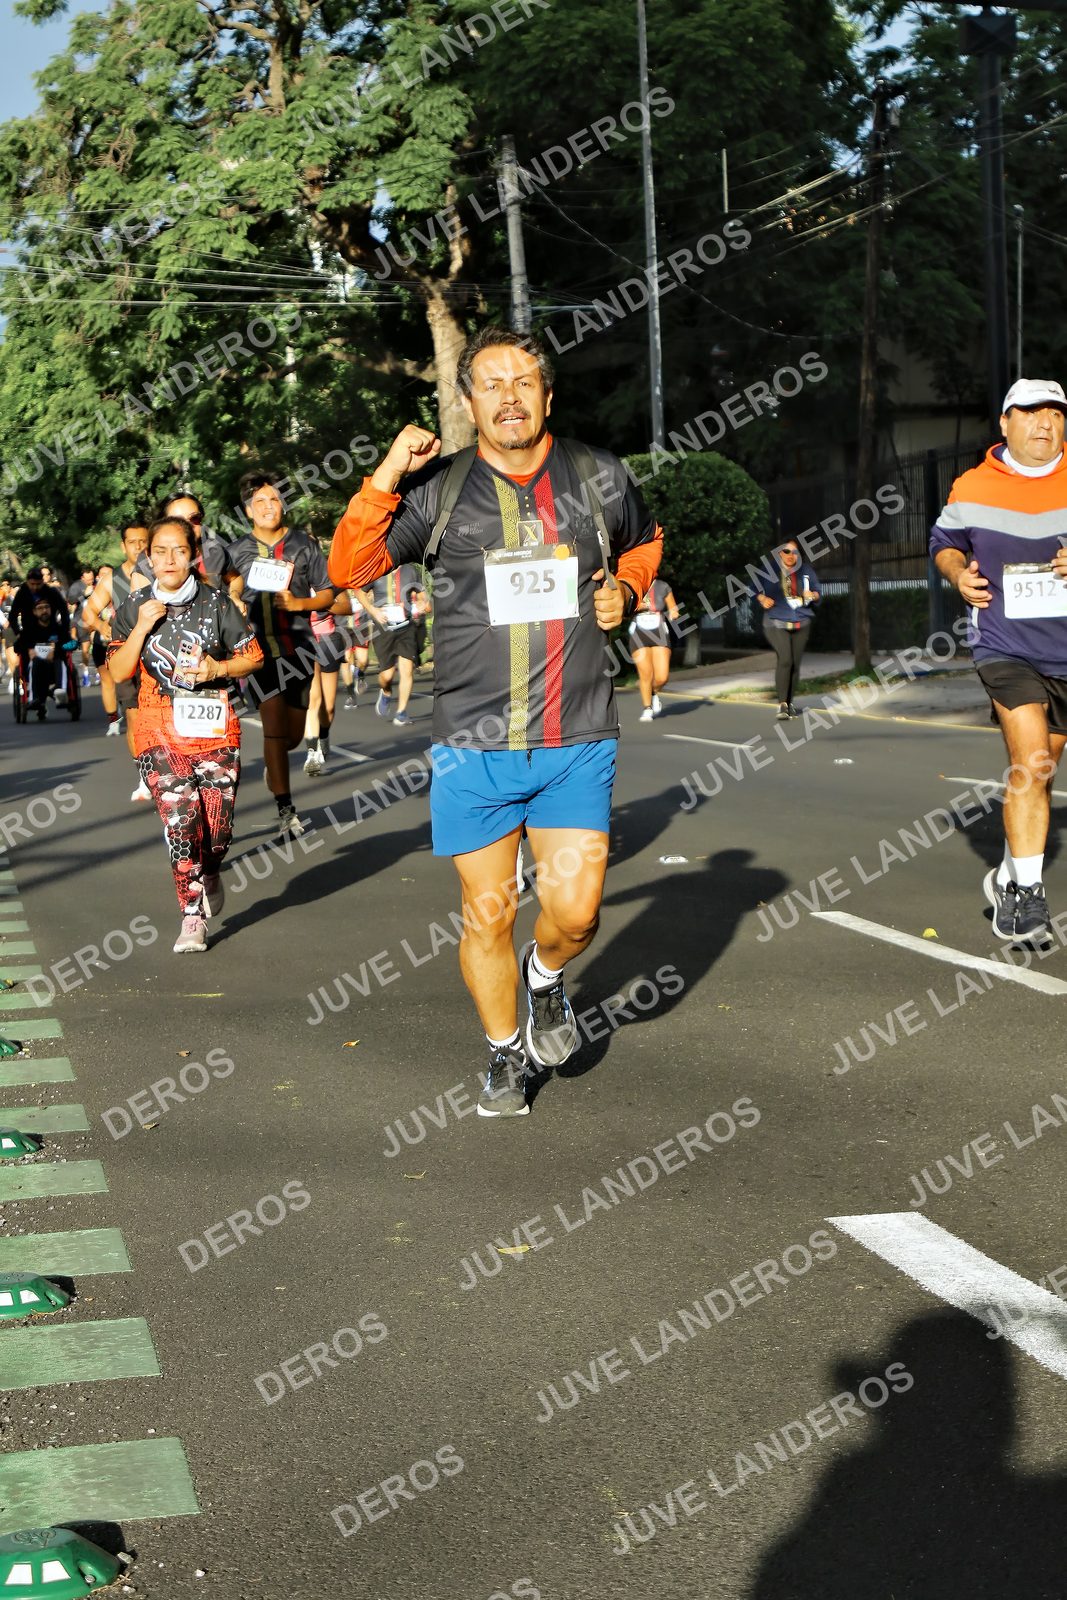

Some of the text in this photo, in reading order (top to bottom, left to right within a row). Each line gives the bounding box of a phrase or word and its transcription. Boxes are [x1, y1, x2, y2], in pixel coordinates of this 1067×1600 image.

[254, 566, 285, 582] 10056
[510, 569, 556, 595] 925
[1014, 580, 1056, 598] 9512
[178, 704, 222, 720] 12287
